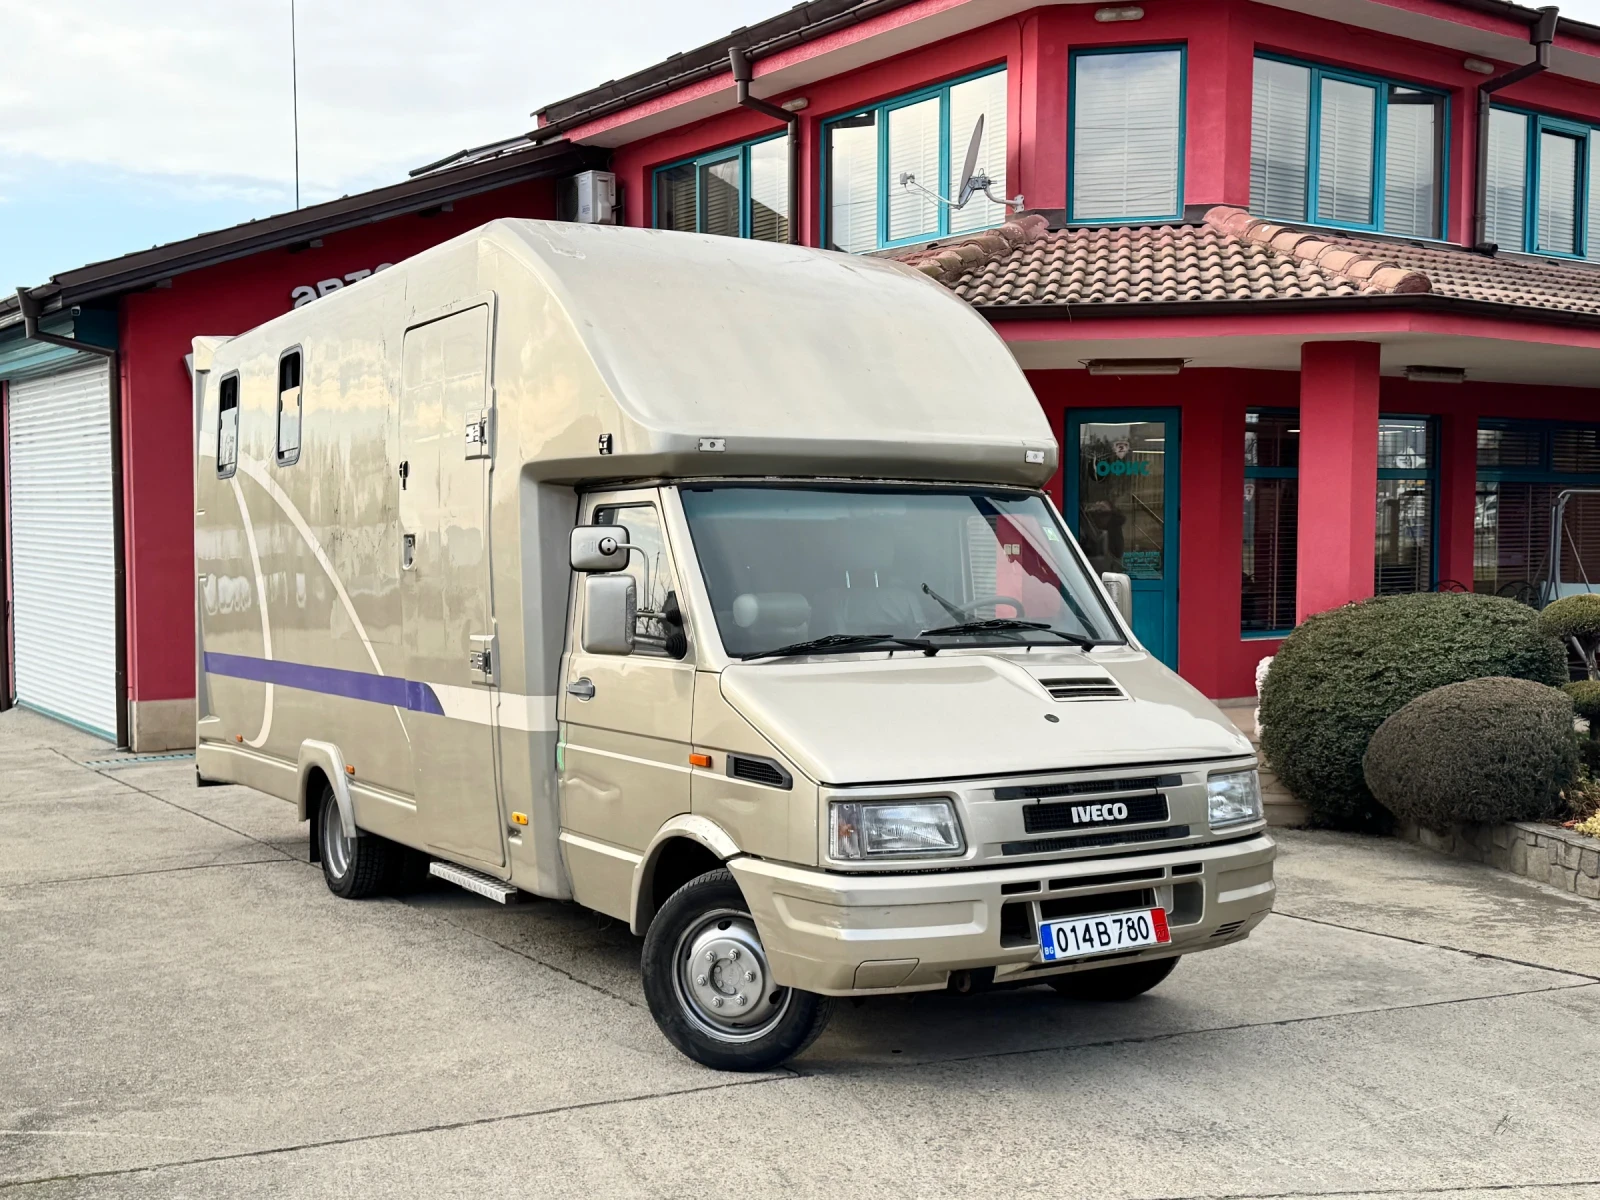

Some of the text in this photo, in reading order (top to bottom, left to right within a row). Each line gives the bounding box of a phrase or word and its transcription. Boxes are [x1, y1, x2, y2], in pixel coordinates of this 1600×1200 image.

[1096, 459, 1150, 477] ОФИС
[1071, 802, 1128, 824] IVECO
[1044, 946, 1054, 955] BG
